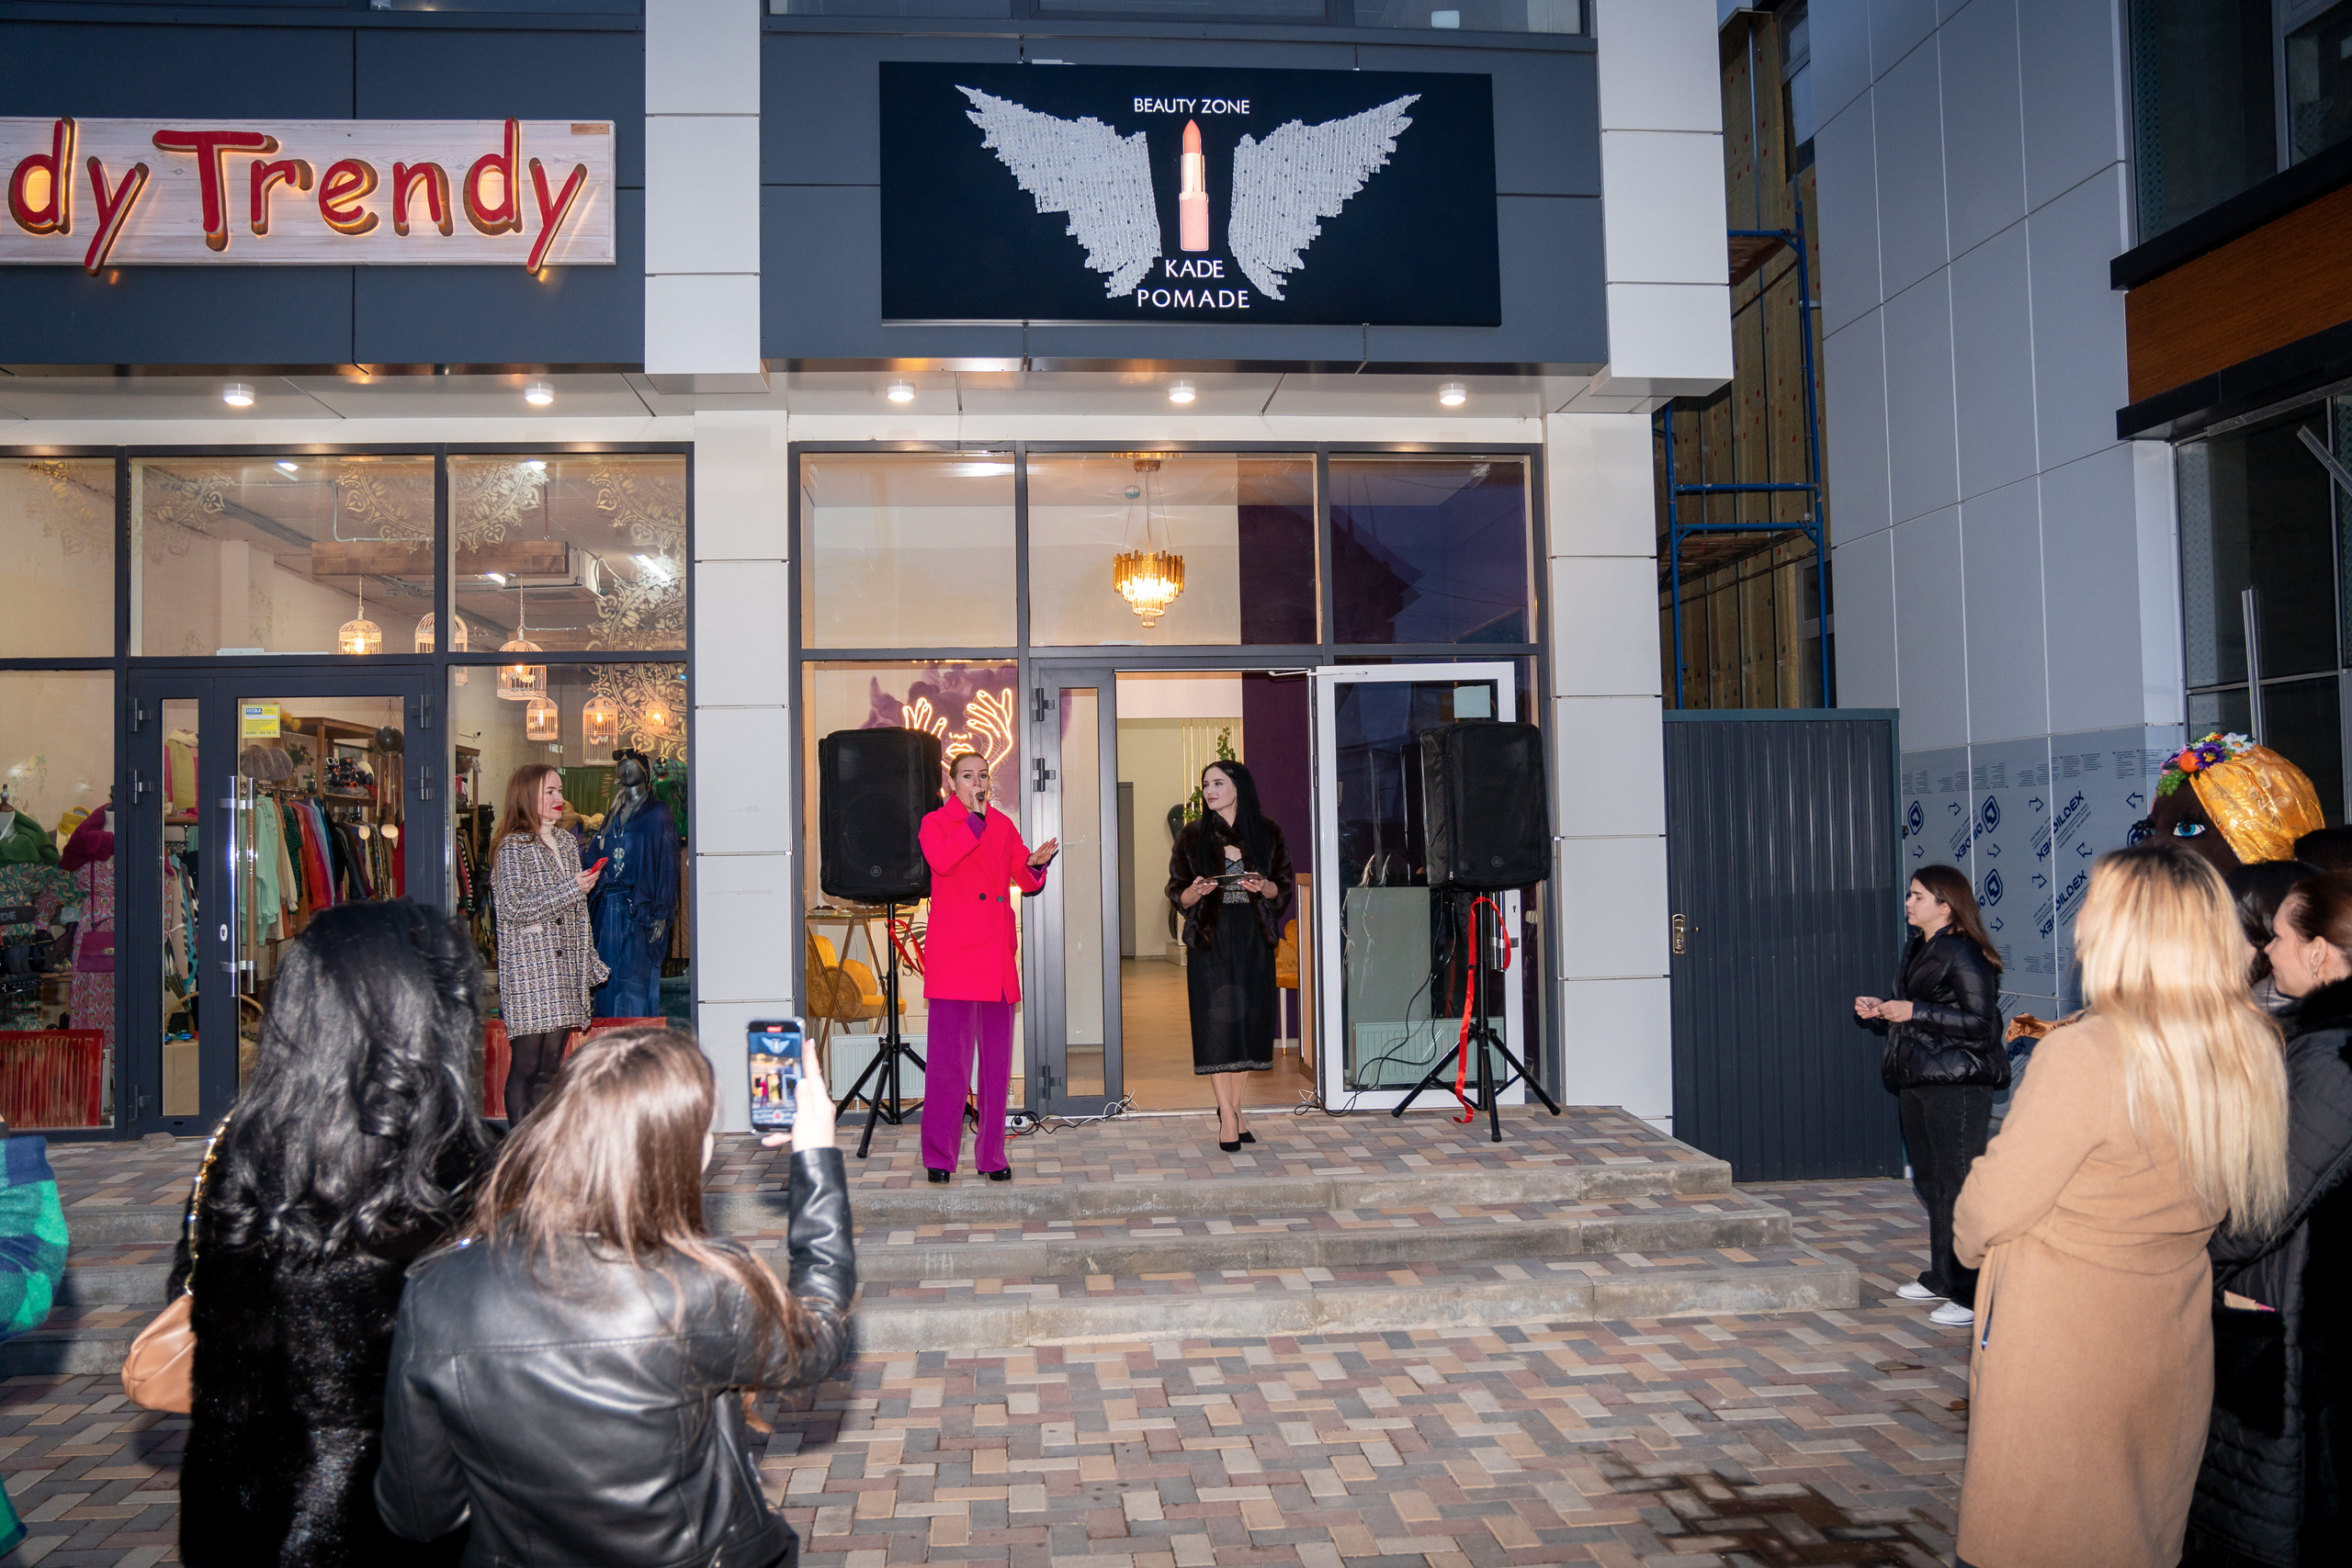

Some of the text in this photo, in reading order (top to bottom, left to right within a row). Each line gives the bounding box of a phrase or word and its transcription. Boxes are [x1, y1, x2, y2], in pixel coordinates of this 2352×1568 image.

[1133, 97, 1250, 115] BEAUTY ZONE
[153, 117, 588, 275] Trendy
[1164, 258, 1226, 278] KADE
[1136, 288, 1250, 309] POMADE
